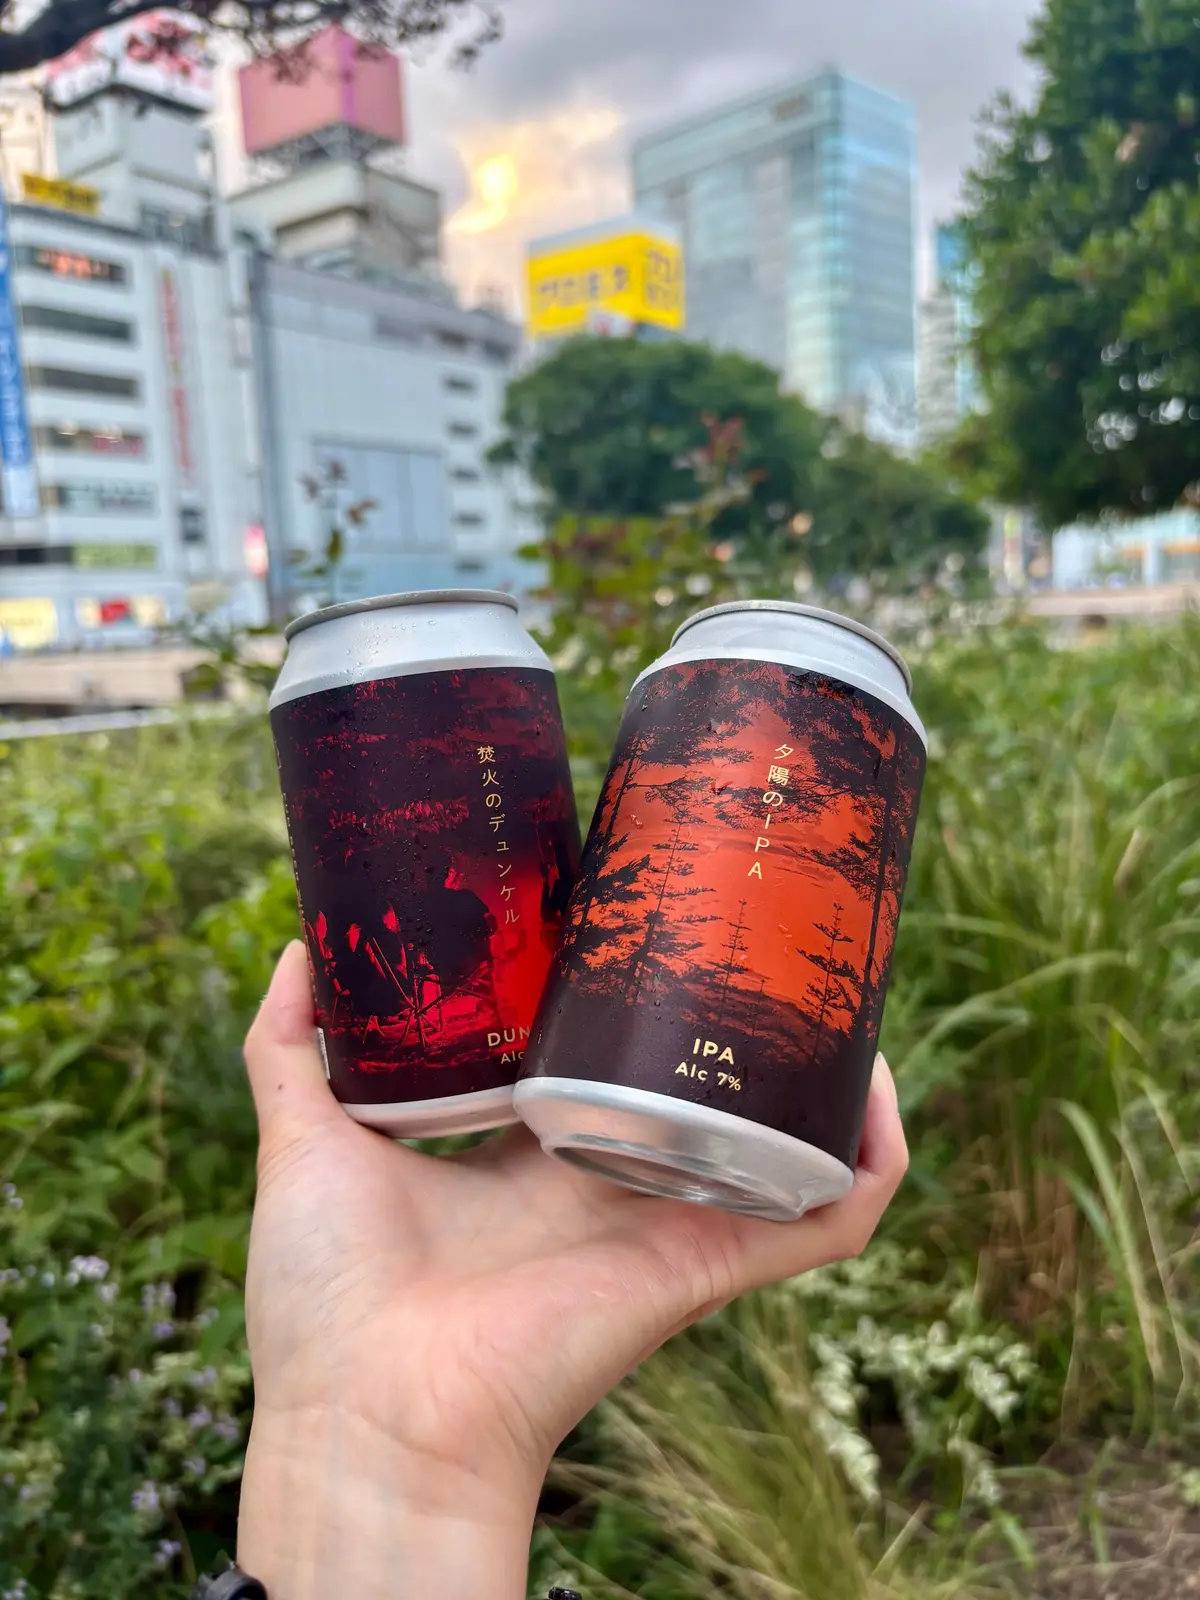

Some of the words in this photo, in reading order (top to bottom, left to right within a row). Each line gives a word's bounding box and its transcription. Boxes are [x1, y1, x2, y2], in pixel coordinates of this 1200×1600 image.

[476, 745, 521, 925] 焚火のデュンケル
[692, 1037, 735, 1065] IPA
[674, 1061, 708, 1081] Alc
[717, 1071, 741, 1091] 7%
